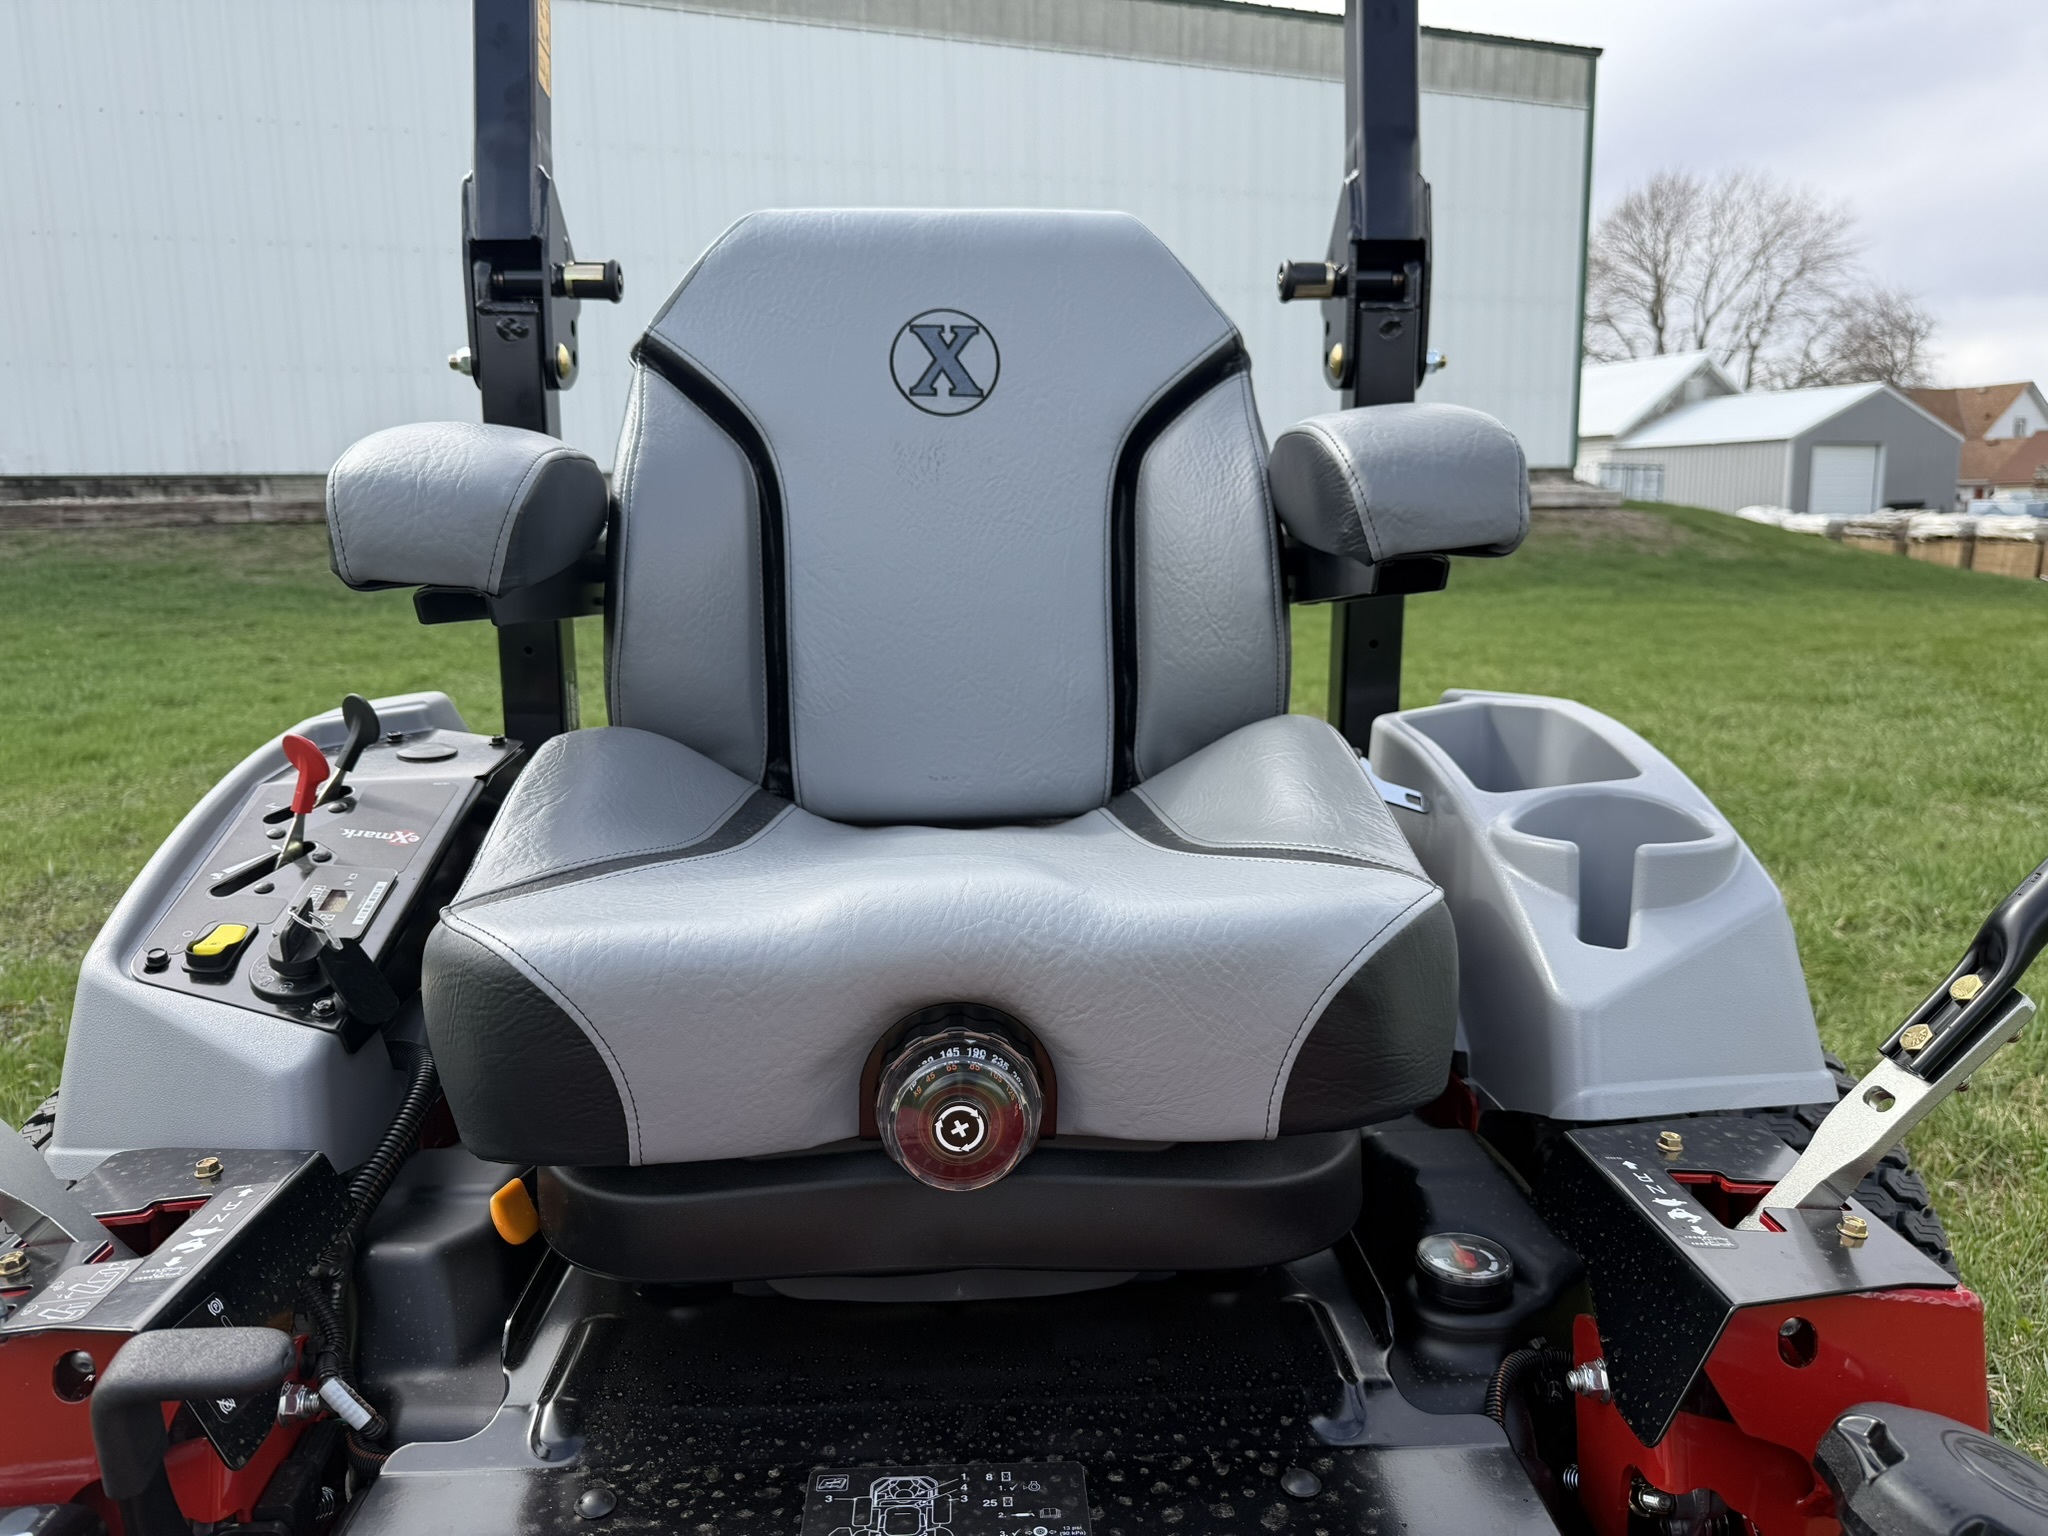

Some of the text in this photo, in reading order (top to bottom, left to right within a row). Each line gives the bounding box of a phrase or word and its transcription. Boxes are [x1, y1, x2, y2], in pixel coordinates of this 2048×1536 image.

[909, 324, 984, 399] X
[341, 828, 420, 845] eXmark
[939, 1047, 960, 1058] 145
[966, 1047, 987, 1059] 190
[991, 1054, 1010, 1071] 235
[925, 1072, 936, 1083] 45
[946, 1064, 958, 1072] 65
[1645, 1183, 1667, 1195] N
[207, 1212, 230, 1224] N
[985, 1473, 993, 1481] 8
[825, 1495, 833, 1503] 3
[960, 1495, 968, 1503] 3
[982, 1499, 998, 1507] 25
